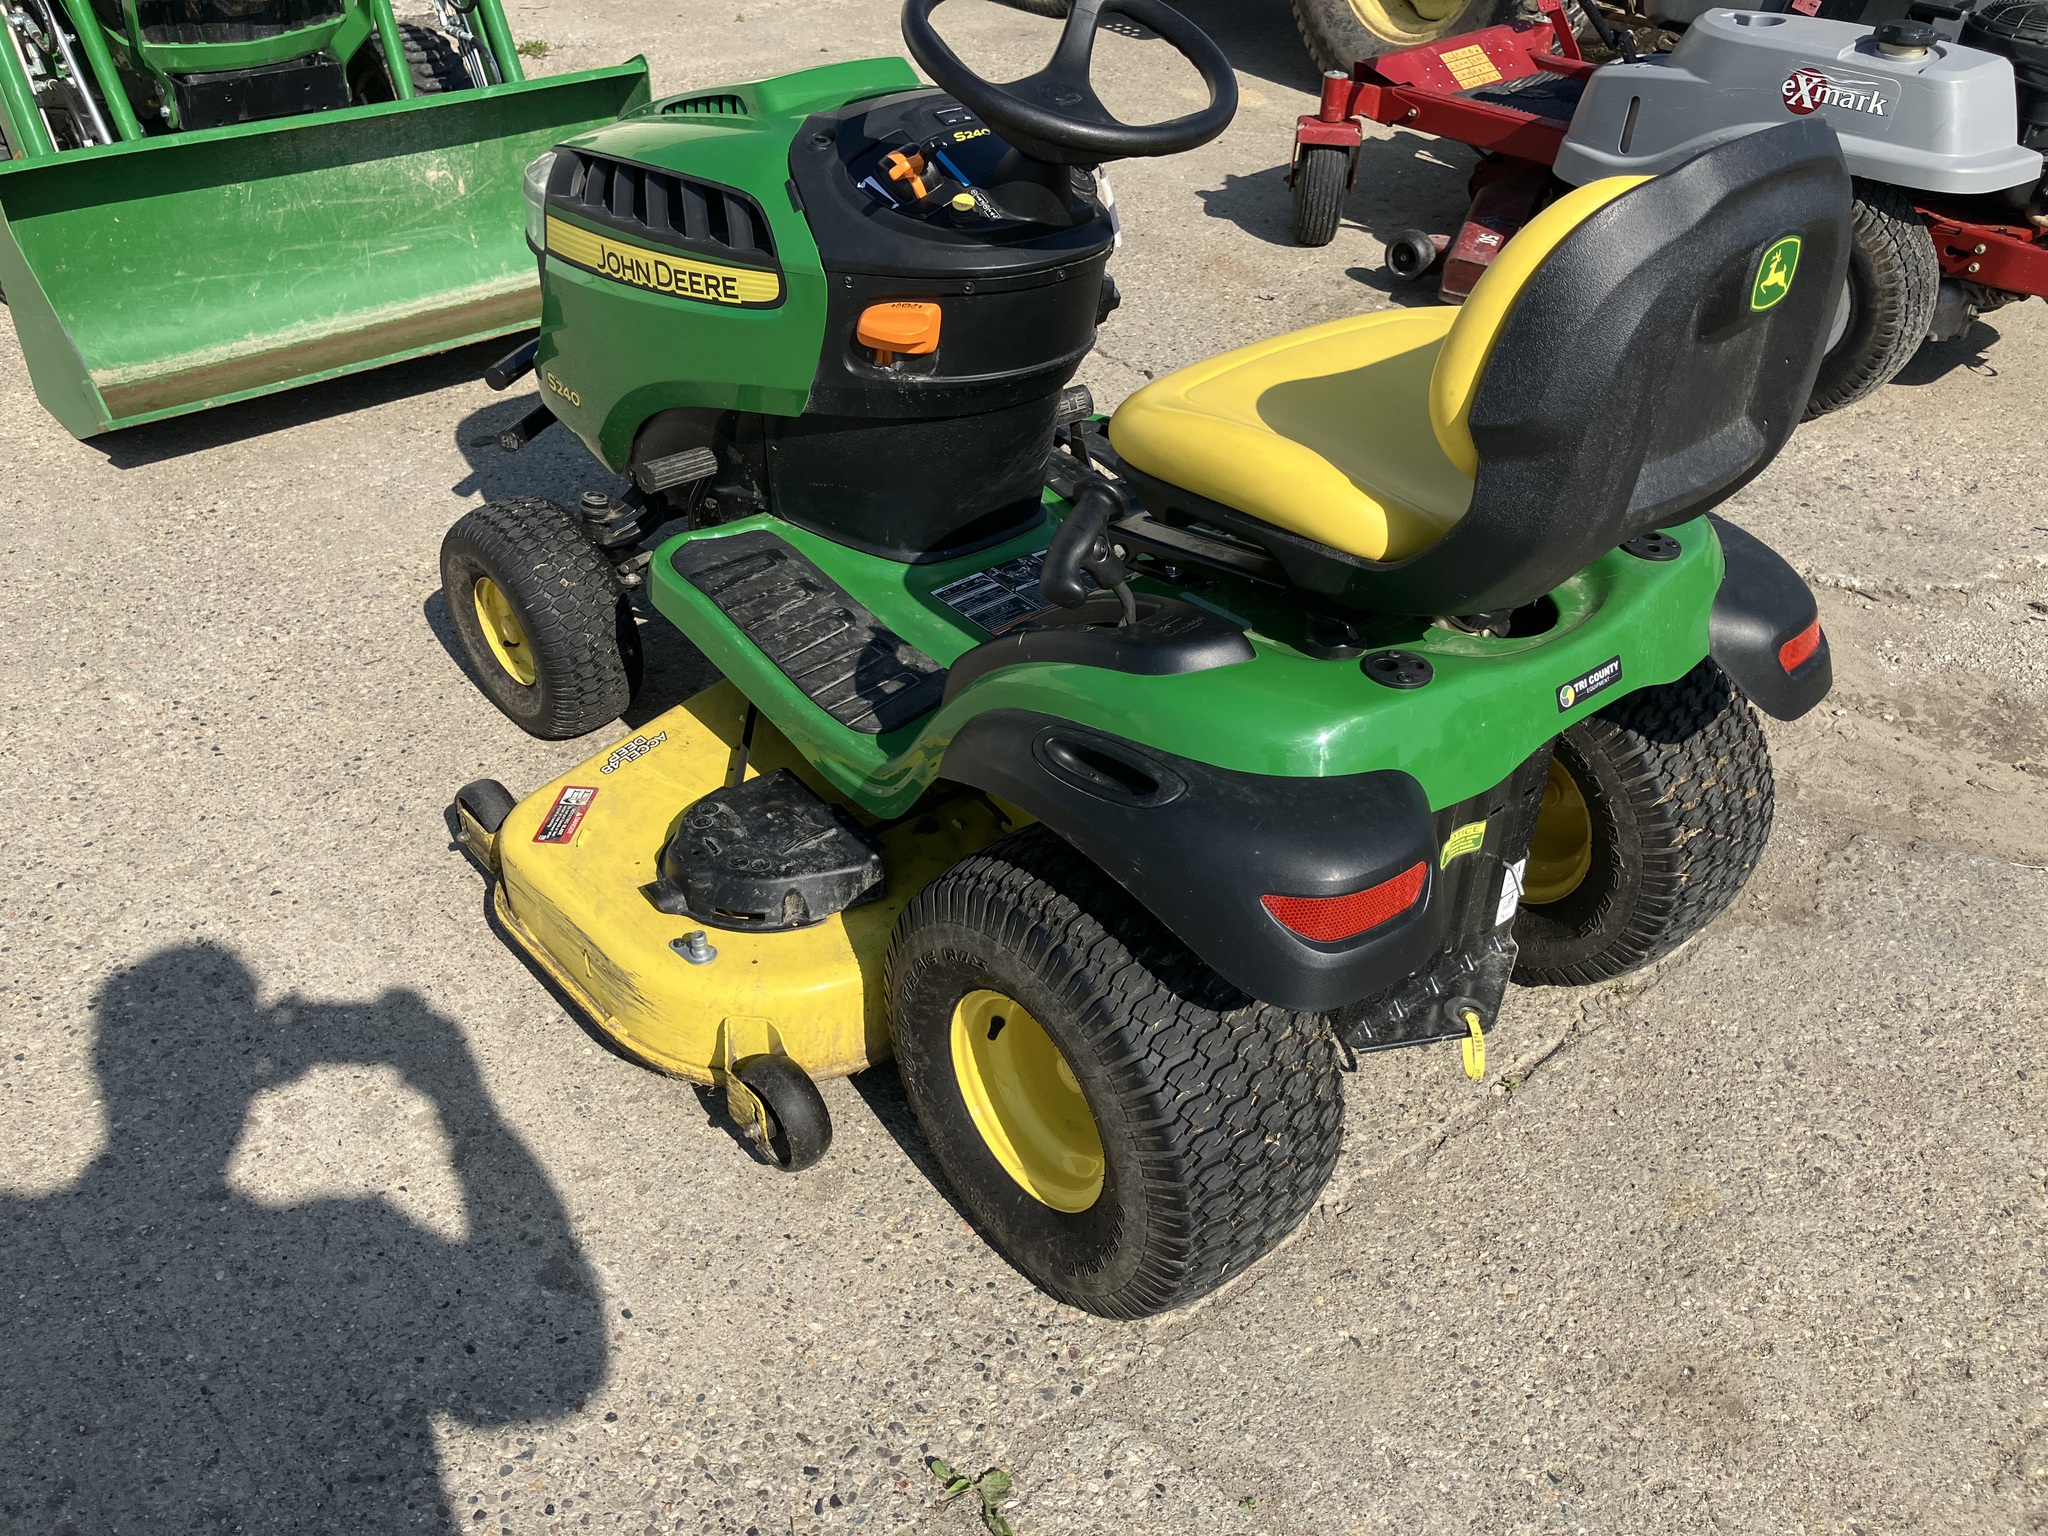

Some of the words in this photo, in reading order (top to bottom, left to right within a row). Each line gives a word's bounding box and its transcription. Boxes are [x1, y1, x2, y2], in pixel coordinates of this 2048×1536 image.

[953, 128, 991, 142] S240
[597, 245, 652, 284] JOHN
[655, 260, 739, 300] DEERE
[547, 371, 582, 407] S240
[1573, 678, 1588, 693] TRI
[1588, 660, 1619, 685] COUNTY
[1586, 676, 1610, 694] EQUIPMENT
[610, 735, 648, 764] DEEP
[1451, 825, 1481, 842] OTICE
[902, 950, 938, 1003] TRAC
